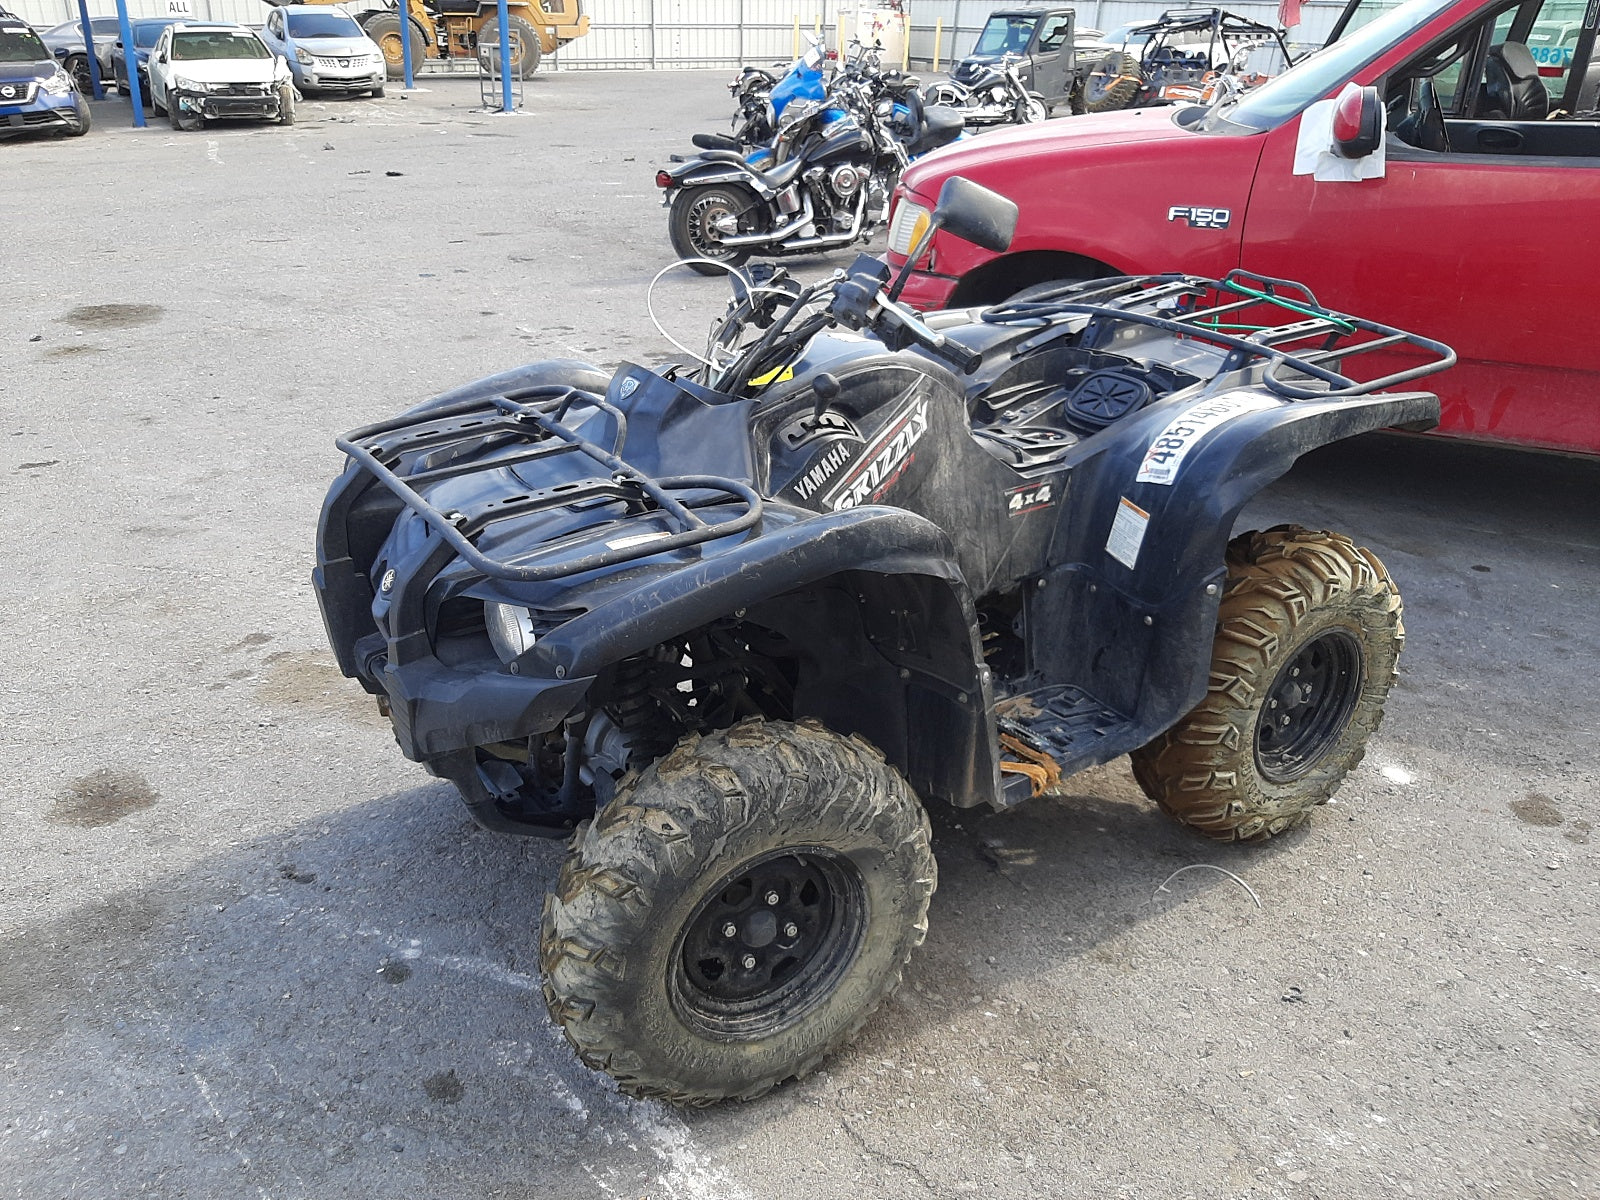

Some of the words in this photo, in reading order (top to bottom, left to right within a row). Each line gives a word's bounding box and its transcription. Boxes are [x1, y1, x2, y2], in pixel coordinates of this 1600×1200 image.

[169, 1, 190, 13] ALL
[793, 442, 851, 501] YAMAHA
[833, 400, 929, 512] GRIZZLY
[1009, 485, 1051, 510] 4x4
